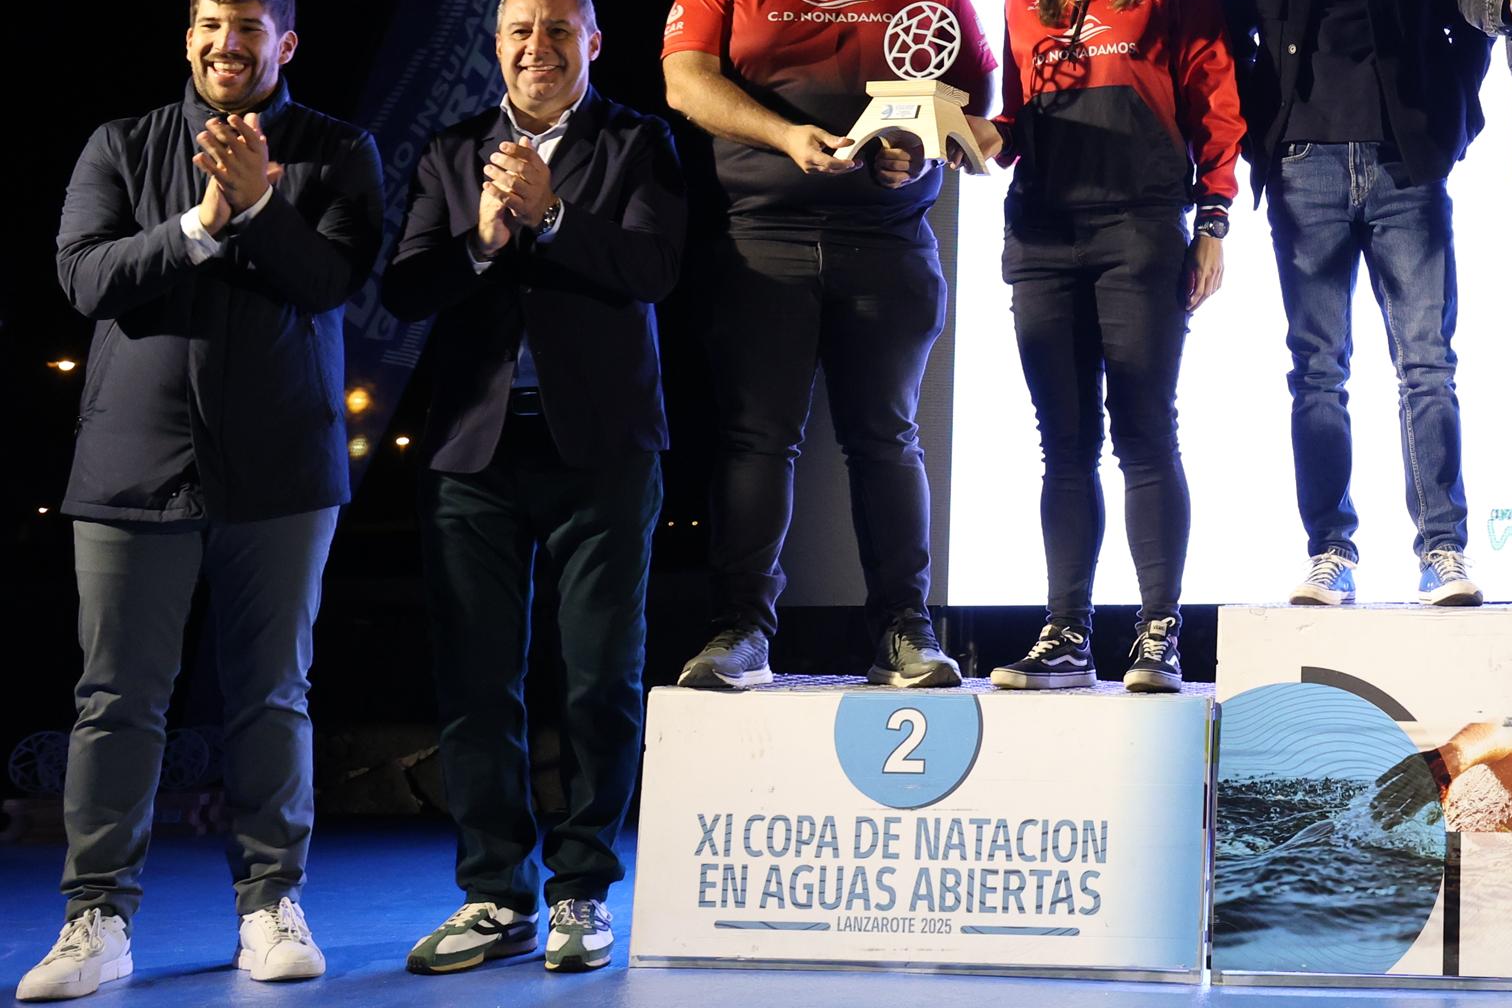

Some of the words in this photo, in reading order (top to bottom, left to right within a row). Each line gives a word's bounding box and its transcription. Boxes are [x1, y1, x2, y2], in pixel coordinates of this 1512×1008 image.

[767, 11, 798, 22] C.D.
[881, 707, 928, 775] 2
[694, 813, 734, 858] XI
[743, 814, 840, 860] COPA
[853, 816, 902, 861] DE
[914, 817, 1109, 865] NATACION
[698, 863, 749, 910] EN
[758, 864, 898, 913] AGUAS
[908, 867, 1101, 917] ABIERTAS
[836, 915, 916, 935] LANZAROTE
[920, 917, 953, 936] 2025
